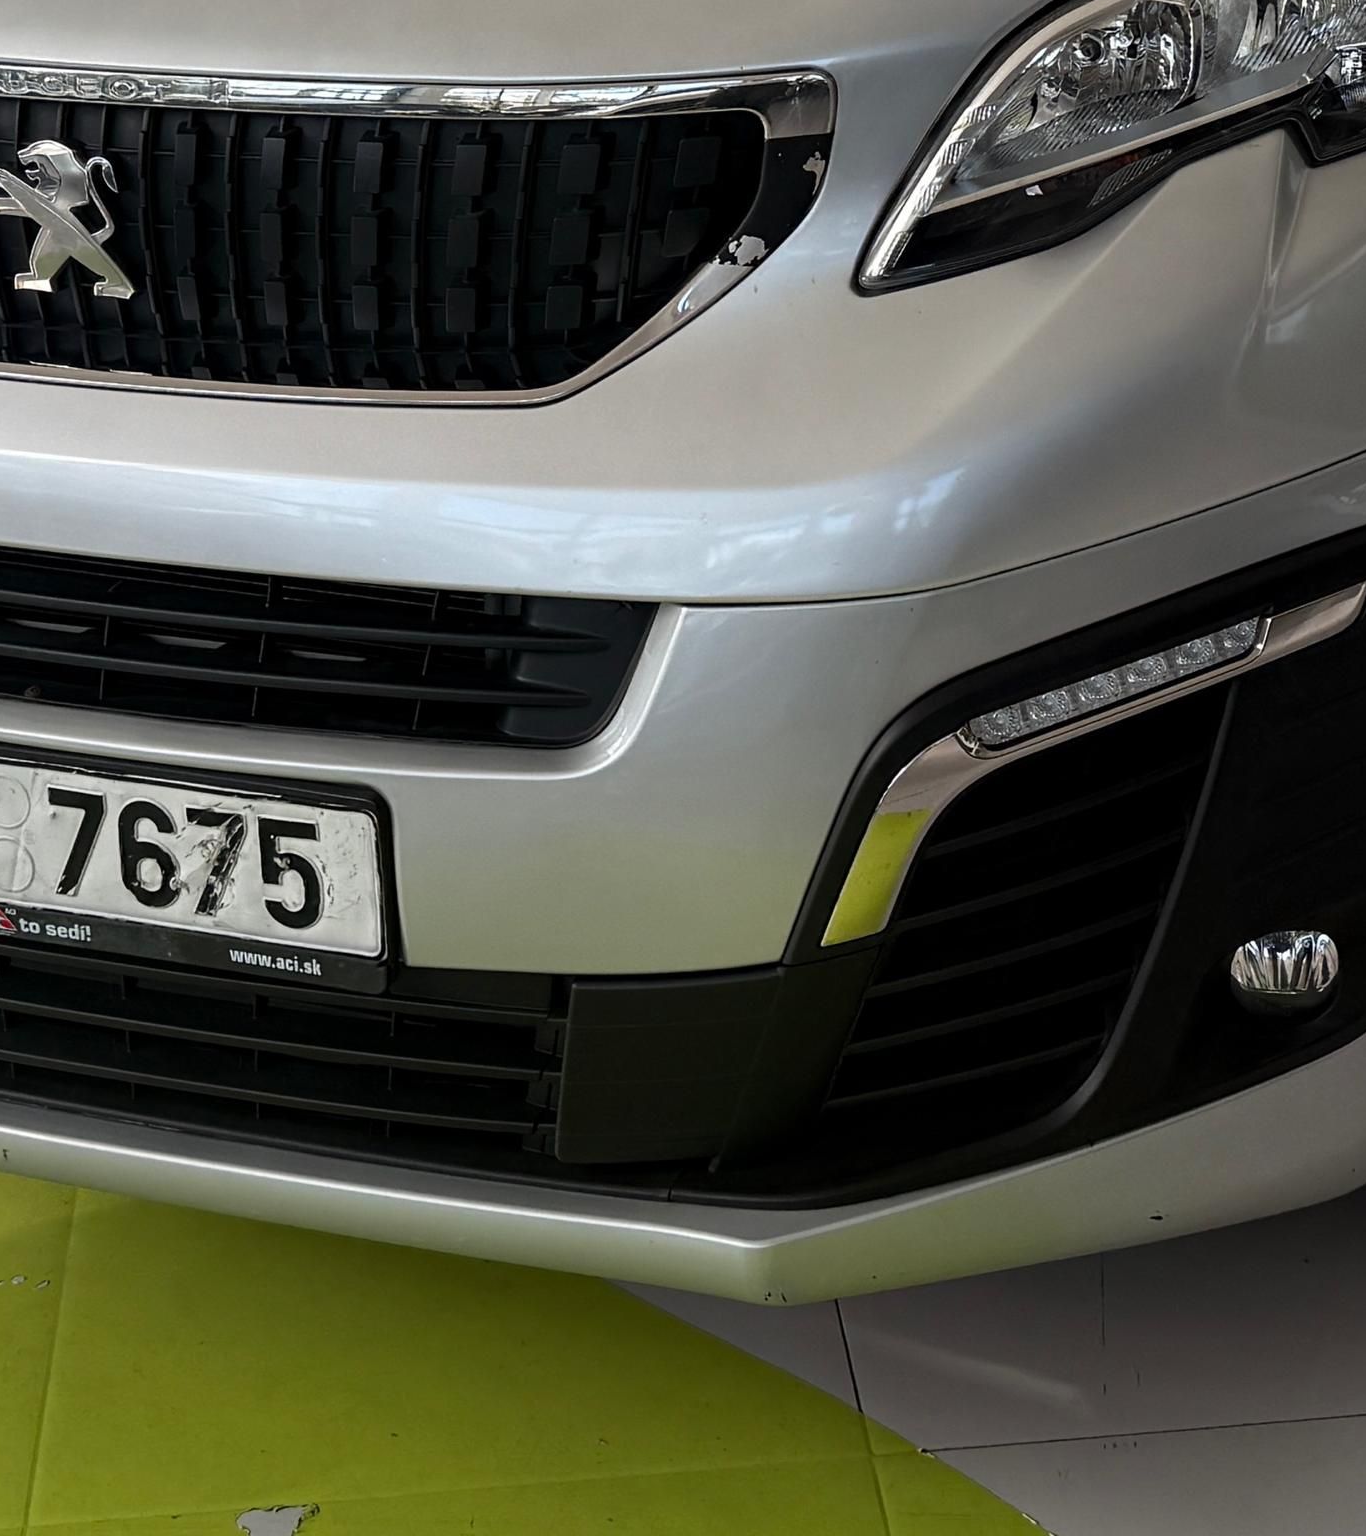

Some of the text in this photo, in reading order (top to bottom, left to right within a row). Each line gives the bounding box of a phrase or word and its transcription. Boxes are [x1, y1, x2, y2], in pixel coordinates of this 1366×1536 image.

[46, 783, 325, 930] 7675
[19, 918, 40, 934] to
[229, 949, 322, 976] www.aci.sk
